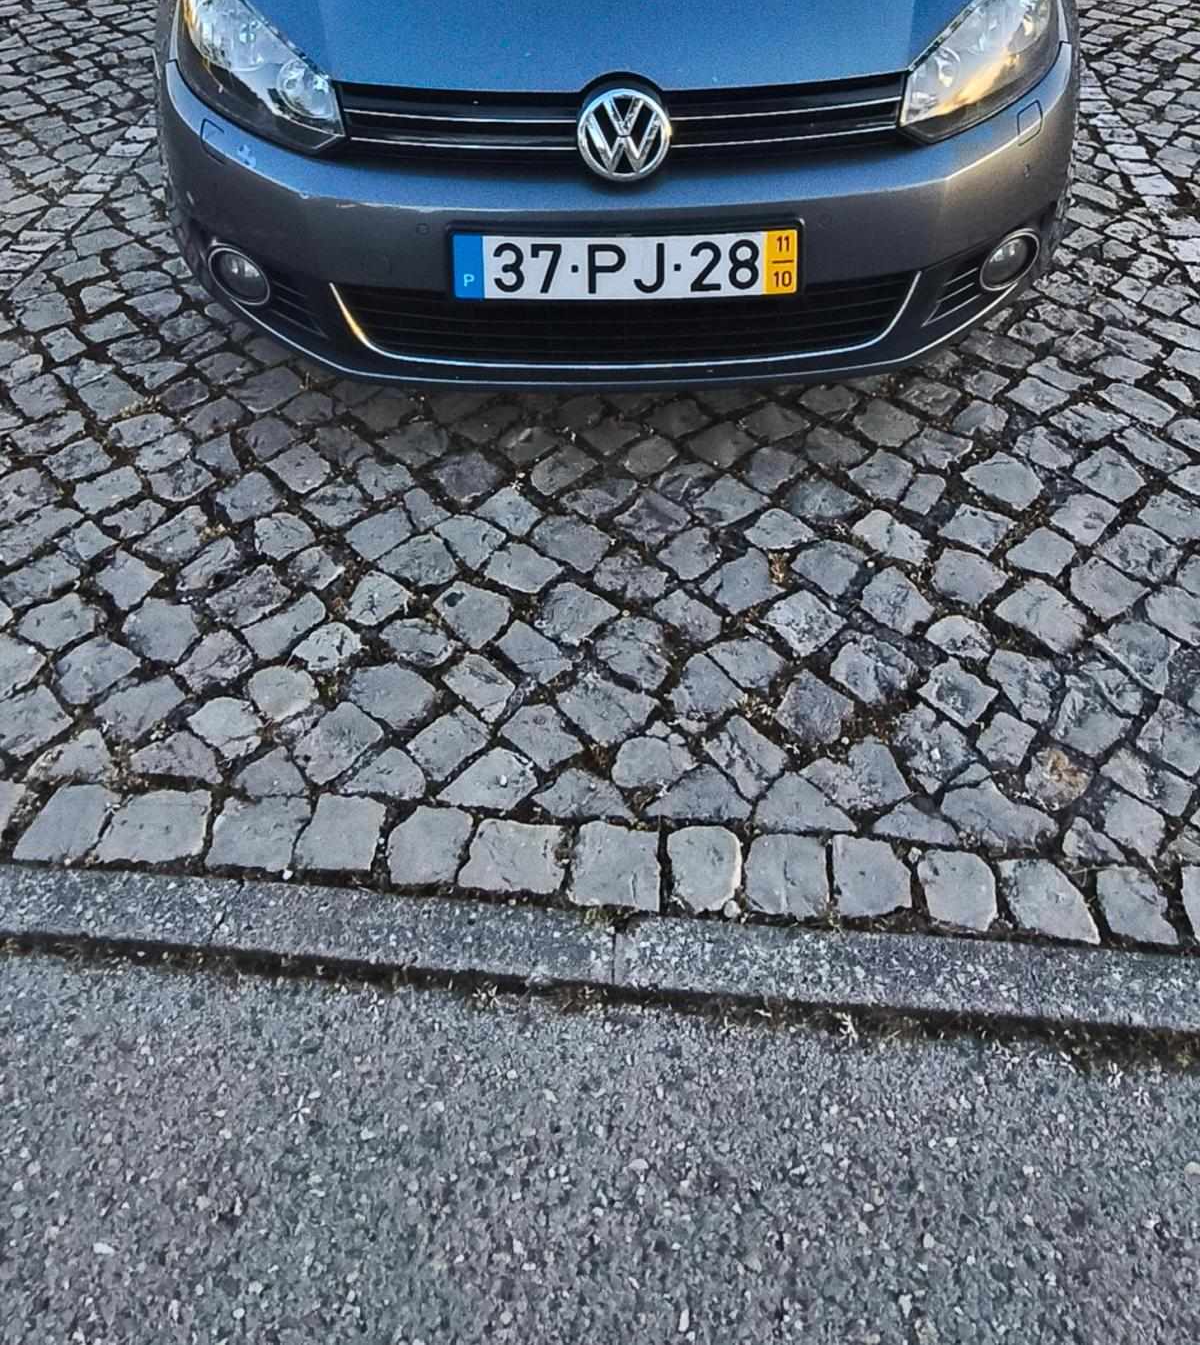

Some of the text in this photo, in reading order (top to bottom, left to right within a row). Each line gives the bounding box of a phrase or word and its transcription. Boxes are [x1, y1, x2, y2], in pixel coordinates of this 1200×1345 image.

[580, 92, 667, 178] VW
[776, 236, 791, 252] 11
[463, 274, 475, 287] P
[773, 271, 792, 287] 10
